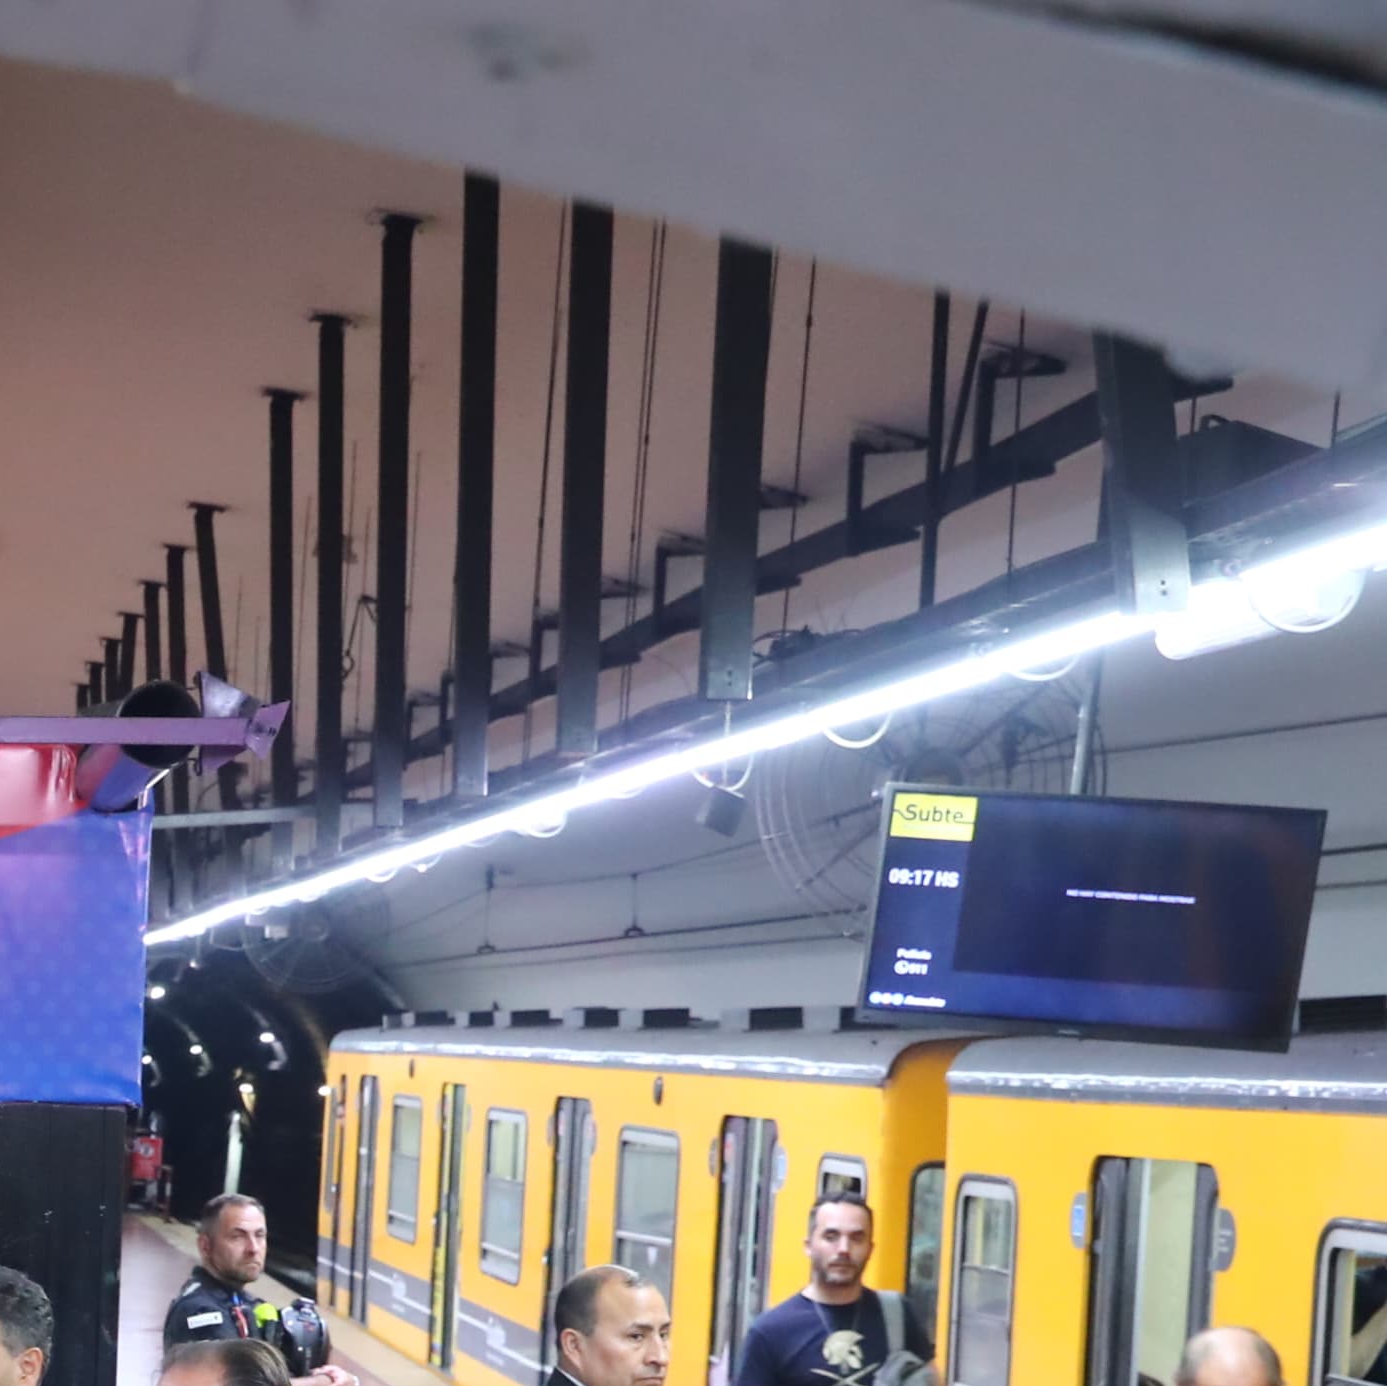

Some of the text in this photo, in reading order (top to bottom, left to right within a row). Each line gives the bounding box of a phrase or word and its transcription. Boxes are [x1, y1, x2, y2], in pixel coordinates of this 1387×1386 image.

[905, 803, 965, 824] Subte
[888, 867, 960, 889] 09:17 HS
